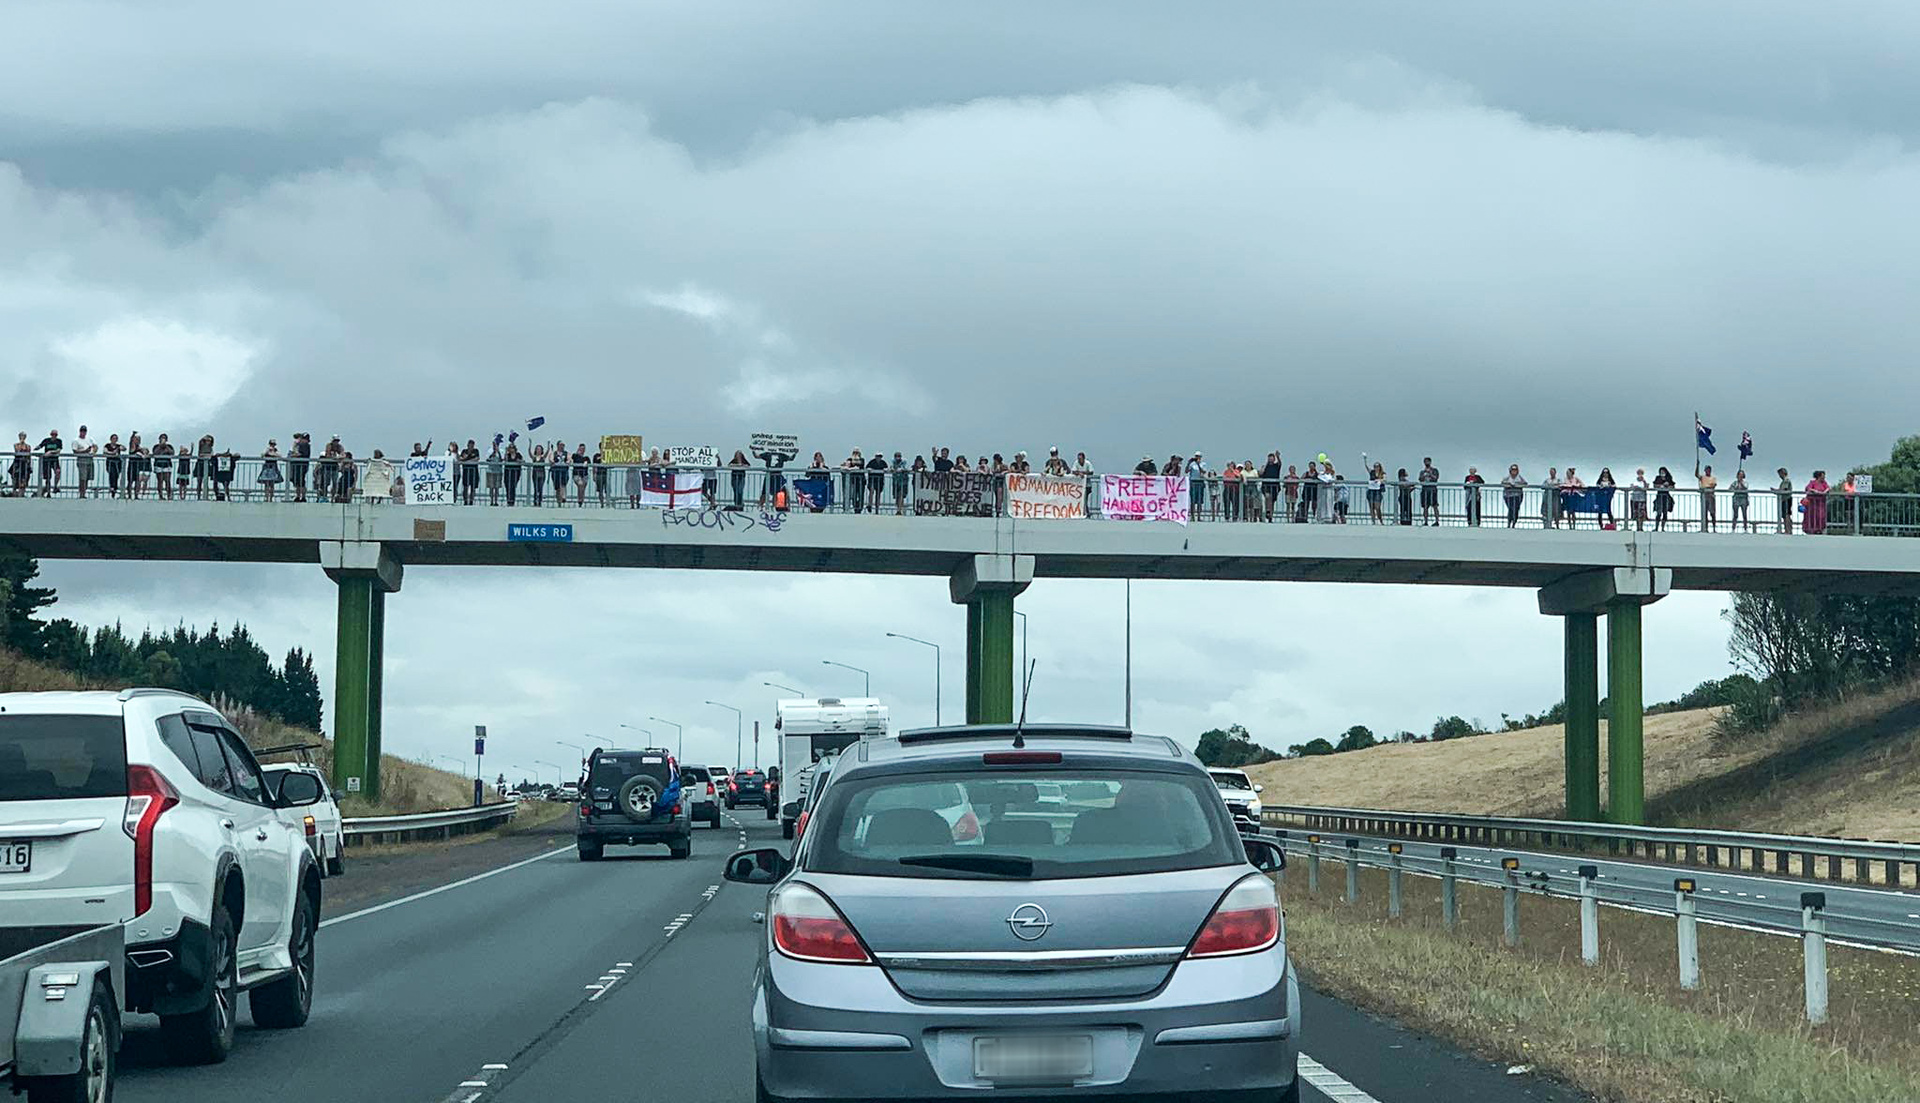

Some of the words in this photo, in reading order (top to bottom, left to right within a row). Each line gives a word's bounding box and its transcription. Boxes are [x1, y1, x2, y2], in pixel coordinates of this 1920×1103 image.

[603, 436, 640, 447] FUCK
[671, 447, 695, 457] STOP
[698, 447, 713, 457] ALL
[406, 458, 446, 473] Convoy
[675, 456, 712, 466] MANDATES
[411, 472, 446, 483] 2022
[440, 480, 452, 492] NZ
[1105, 475, 1157, 497] FREE
[416, 492, 444, 502] BACK
[1147, 494, 1178, 513] OFF
[513, 527, 547, 537] WILKS
[553, 527, 568, 537] RD
[0, 846, 27, 865] 16
